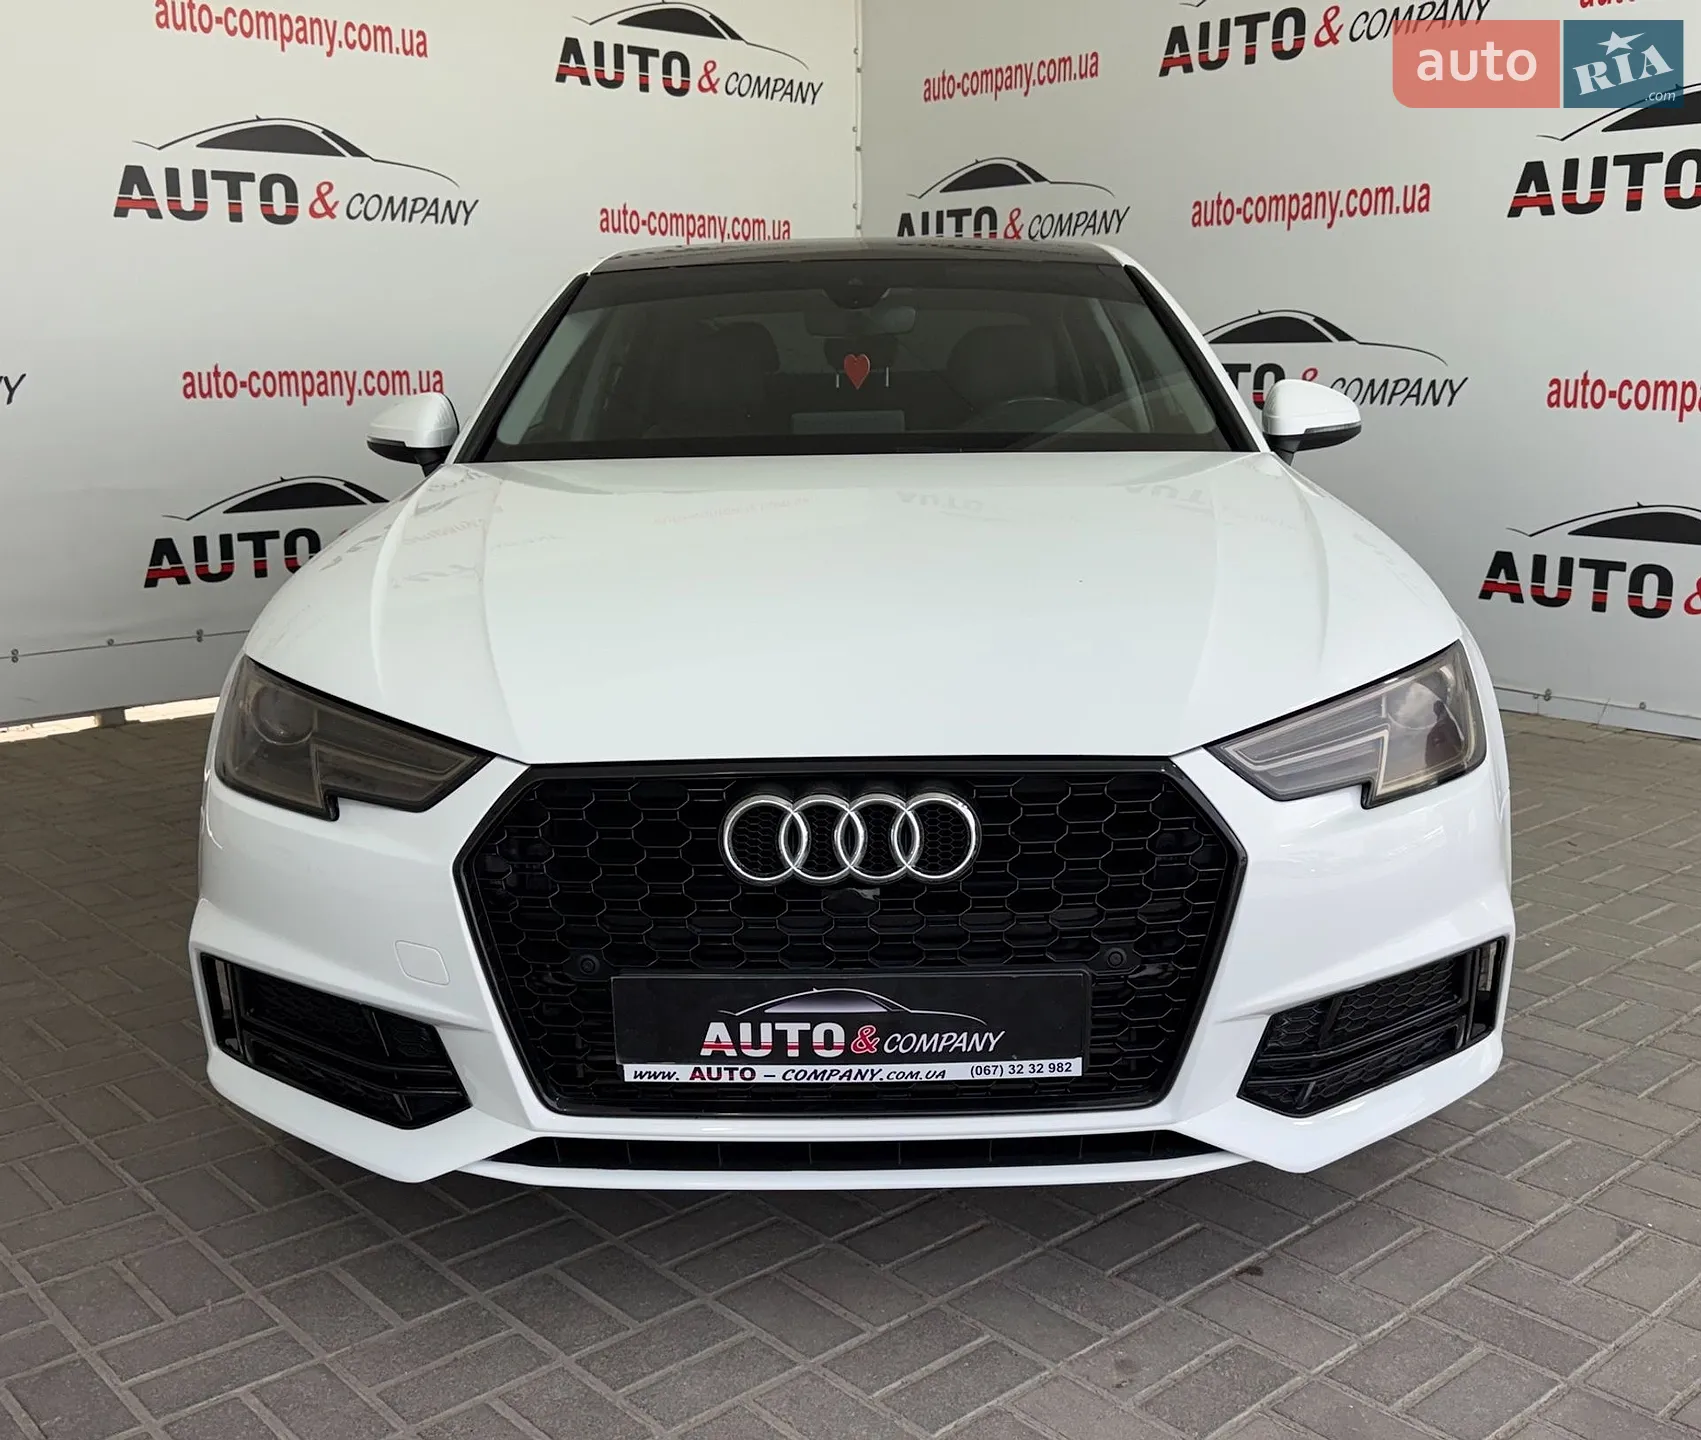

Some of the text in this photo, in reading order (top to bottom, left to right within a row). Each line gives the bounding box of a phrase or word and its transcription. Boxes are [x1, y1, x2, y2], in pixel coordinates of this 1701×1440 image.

[155, 0, 428, 58] auto-company.com.ua
[1159, 0, 1490, 77] AUTO & COMPANY
[556, 36, 823, 105] AUTO & COMPANY
[924, 51, 1100, 102] auto-company.com.ua
[113, 164, 479, 226] AUTO & COMPANY
[1191, 182, 1431, 230] auto-company.com.ua
[1507, 149, 1701, 218] AUTO
[600, 203, 791, 245] auto-company.com.ua
[1003, 207, 1025, 240] &
[1028, 206, 1131, 241] COMPANY
[182, 363, 444, 406] auto-company.com.ua
[1546, 370, 1701, 423] auto-comp
[144, 528, 321, 588] AUTO
[1478, 550, 1673, 619] AUTO
[700, 1022, 1005, 1058] AUTO & COMPANY
[689, 1066, 757, 1081] AUTO
[970, 1064, 1004, 1078] (067)
[1008, 1064, 1024, 1075] 32
[1029, 1063, 1044, 1074] 32
[1048, 1061, 1073, 1073] 982
